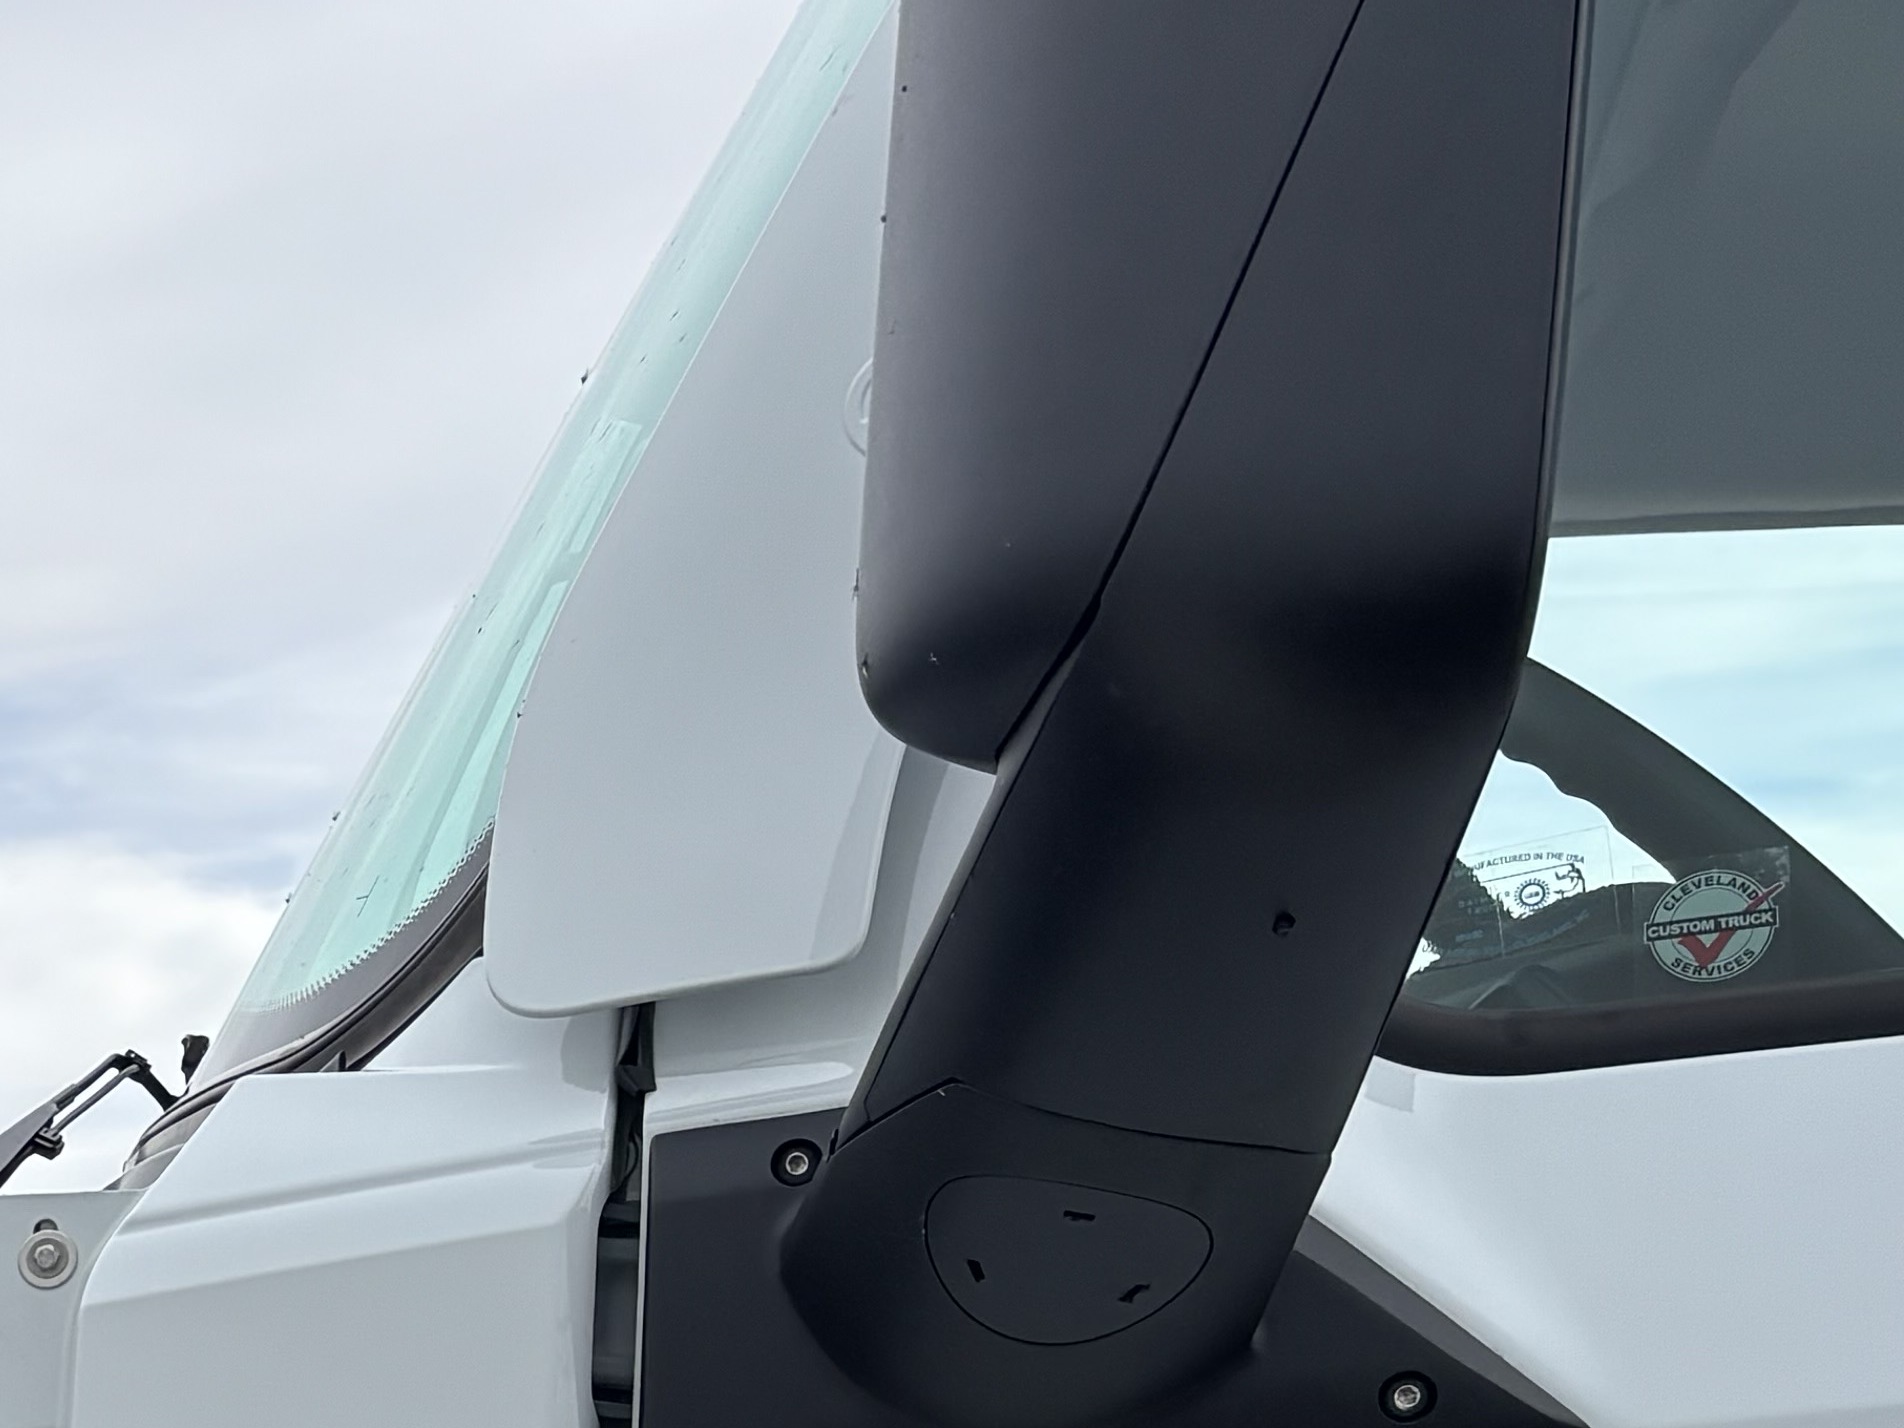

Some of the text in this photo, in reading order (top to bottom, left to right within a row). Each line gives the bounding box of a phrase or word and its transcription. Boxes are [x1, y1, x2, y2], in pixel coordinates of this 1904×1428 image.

[1546, 851, 1564, 861] THE
[1663, 874, 1759, 911] CLEVELAND
[1648, 911, 1774, 938] CUSTOM TRUCK
[1671, 948, 1755, 977] SERVICES
